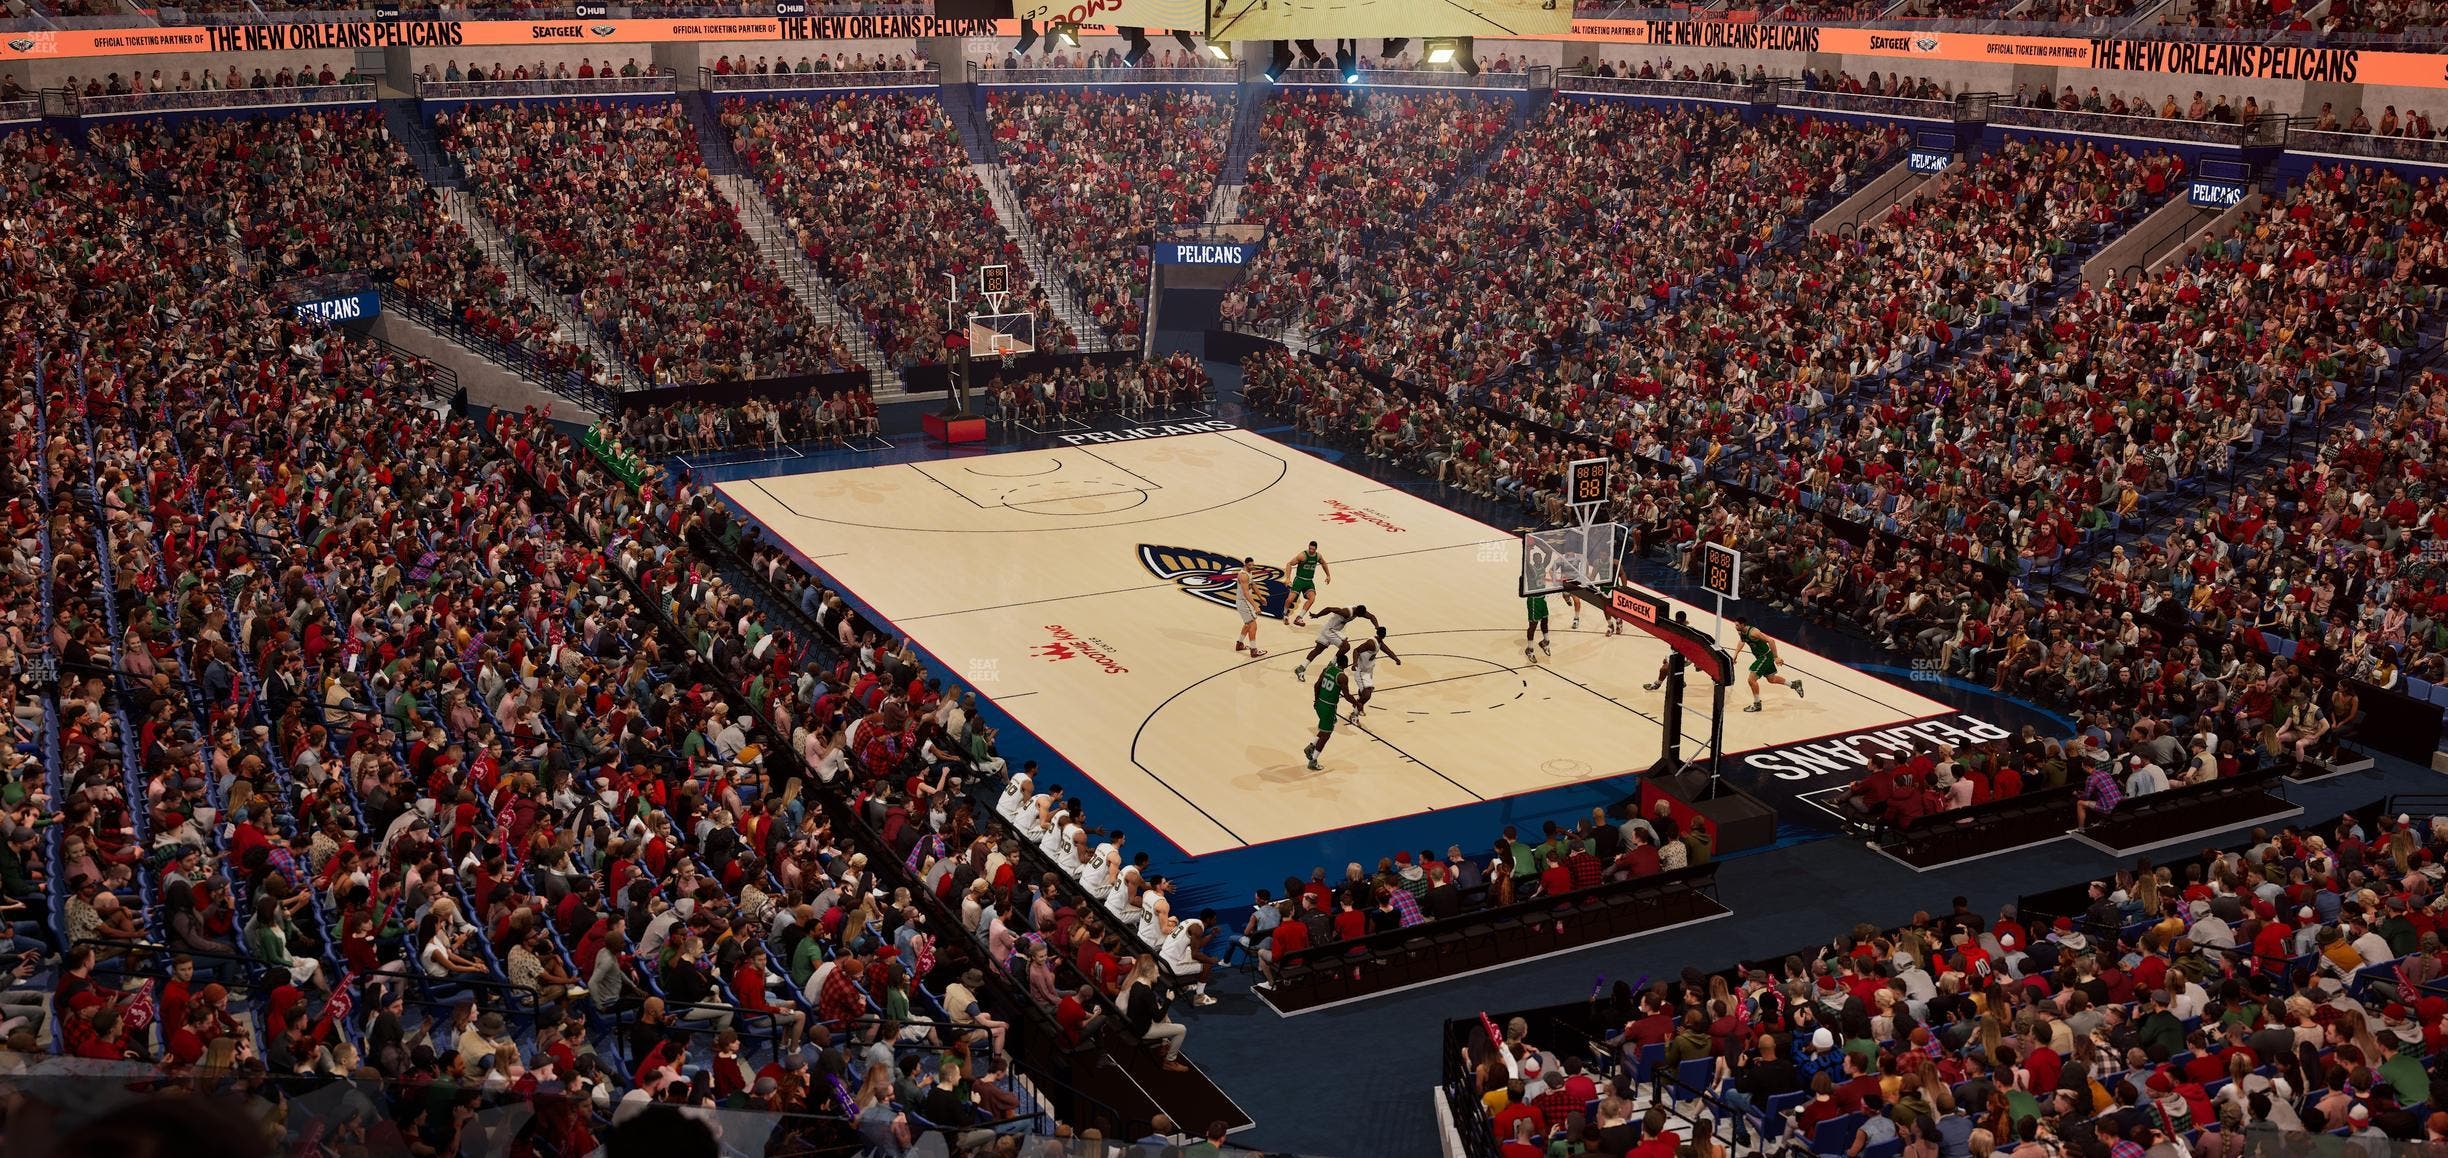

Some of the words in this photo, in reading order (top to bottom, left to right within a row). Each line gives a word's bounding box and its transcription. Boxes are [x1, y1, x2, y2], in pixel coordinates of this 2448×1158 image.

[94, 36, 124, 47] OFFICIAL
[126, 35, 159, 46] TICKETING
[160, 35, 192, 45] PARTNER
[195, 35, 204, 43] OF
[206, 26, 241, 51] THE
[245, 25, 285, 50] NEW
[289, 23, 371, 49] ORLEANS
[374, 21, 463, 47] PELICANS
[532, 25, 584, 38] SEATGEEK
[673, 25, 701, 35] OFFICIAL
[704, 25, 737, 34] TICKETING
[739, 24, 767, 33] PARTNER
[769, 24, 777, 32] OF
[778, 17, 808, 39] THE
[811, 16, 847, 39] NEW
[850, 15, 921, 38] ORLEANS
[924, 15, 998, 37] PELICANS
[1646, 21, 1672, 44] THE
[1675, 22, 1703, 46] NEW
[1705, 23, 1758, 49] ORLEANS
[1760, 25, 1820, 52] PELICANS
[1870, 35, 1911, 52] SEATGEEK
[1987, 43, 2014, 55] OFFICIAL
[2015, 45, 2047, 56] TICKETING
[2049, 46, 2077, 57] PARTNER
[2079, 48, 2087, 58] OF
[2090, 40, 2120, 70] THE
[2124, 40, 2166, 72] NEW
[2168, 43, 2255, 77] ORLEANS
[2258, 46, 2358, 83] PELICANS
[1911, 153, 1947, 170] PELICANS
[2192, 184, 2241, 205] PELICANS
[1177, 245, 1242, 264] PELICANS
[1058, 420, 1238, 445] PELICANS
[1579, 479, 1600, 498] 88
[1617, 595, 1651, 618] SEATGEEK
